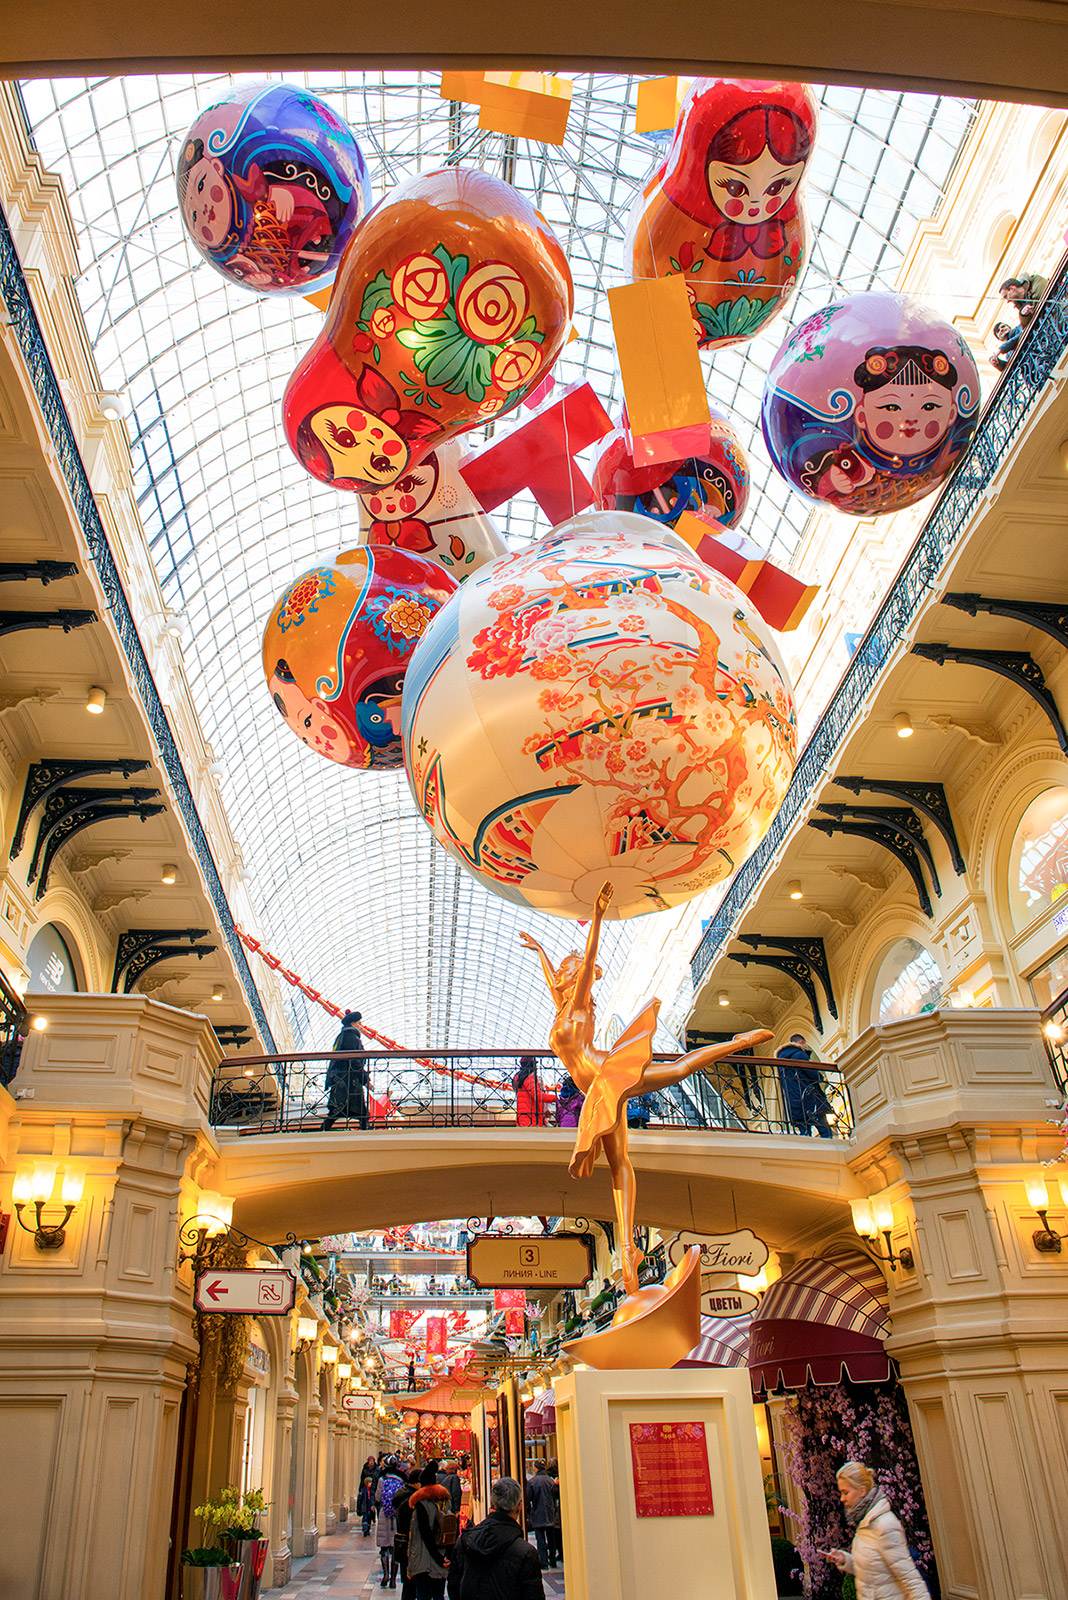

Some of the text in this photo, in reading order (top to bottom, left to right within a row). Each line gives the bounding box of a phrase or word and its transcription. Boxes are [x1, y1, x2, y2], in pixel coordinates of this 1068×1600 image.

[525, 1249, 535, 1263] 3
[700, 1242, 754, 1267] Fiori
[503, 1270, 558, 1278] ЛИНИЯ LINE
[709, 1297, 742, 1312] ЦВЕТЫ
